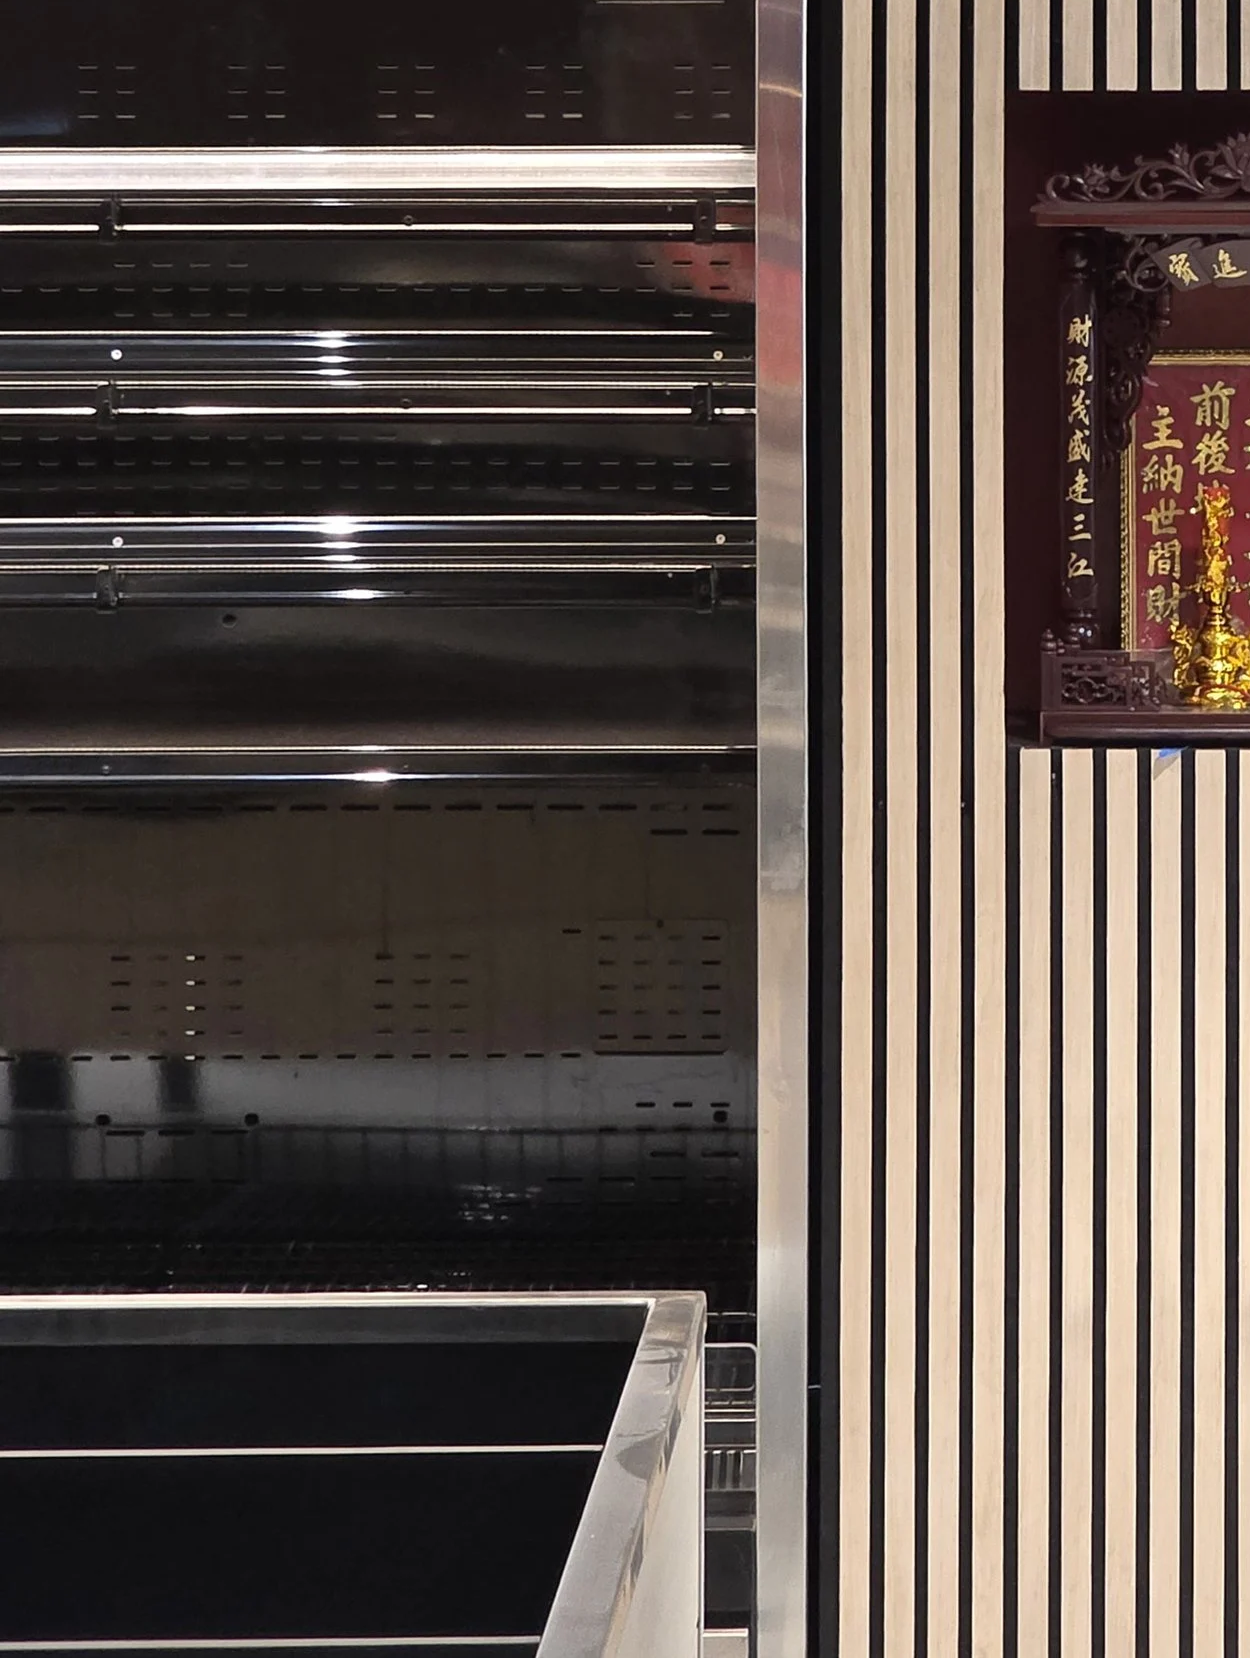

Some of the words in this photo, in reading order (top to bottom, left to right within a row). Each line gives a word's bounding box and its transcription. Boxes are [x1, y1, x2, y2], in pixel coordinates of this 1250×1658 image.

[1141, 405, 1188, 624] 主納世間財
